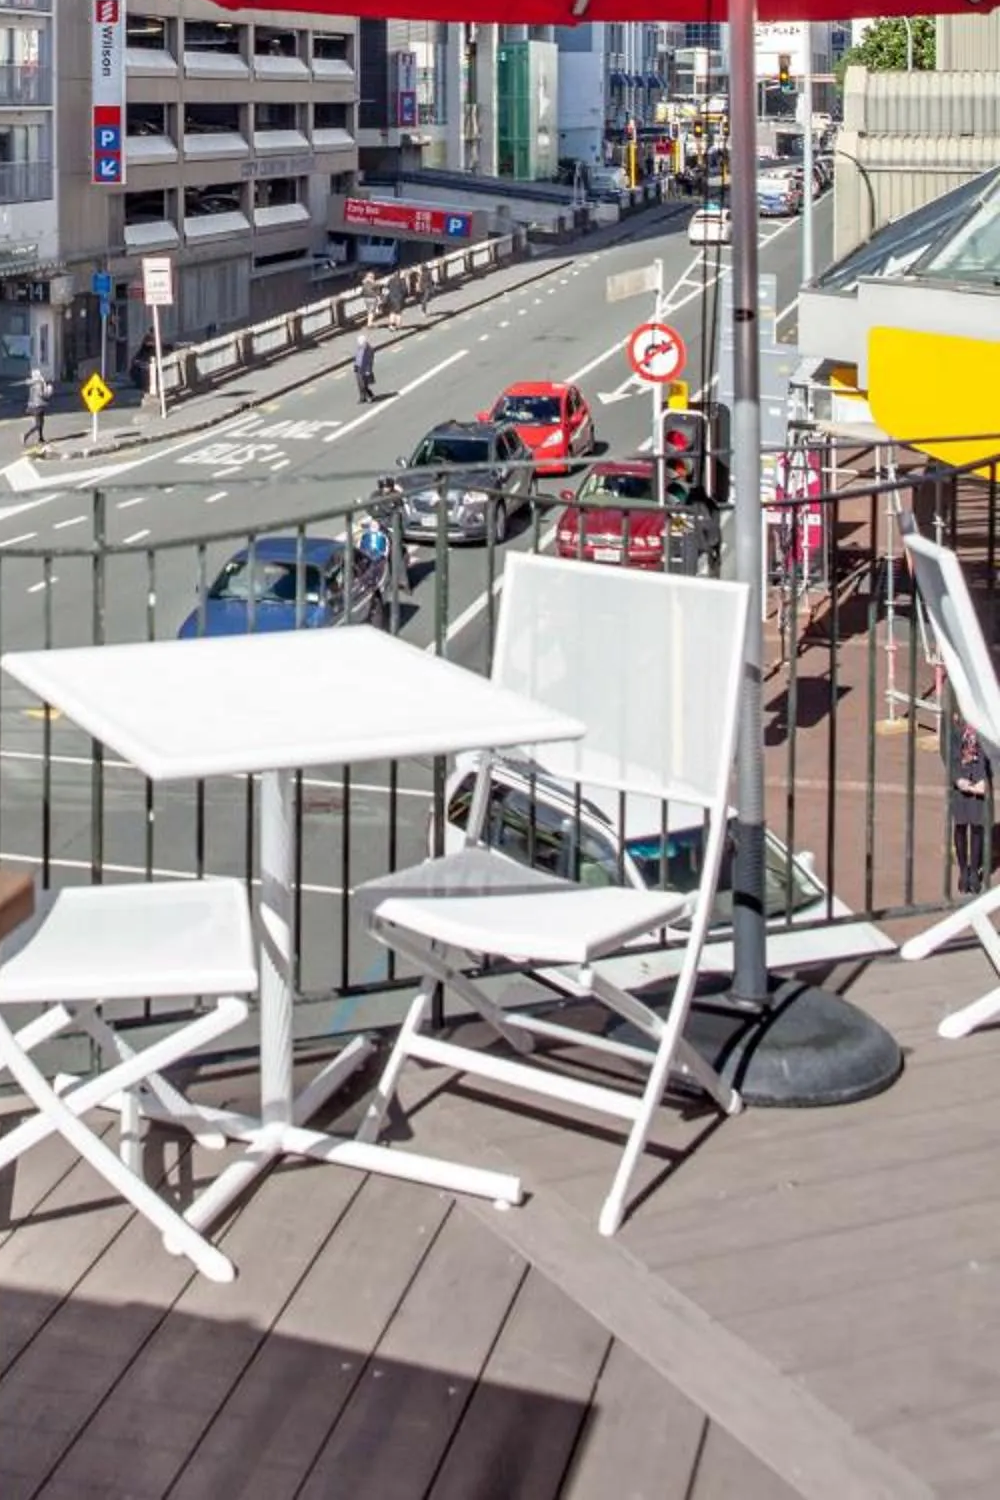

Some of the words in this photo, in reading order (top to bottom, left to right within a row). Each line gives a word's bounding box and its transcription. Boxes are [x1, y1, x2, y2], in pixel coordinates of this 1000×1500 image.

[102, 25, 114, 77] Wilson
[101, 130, 115, 148] P
[449, 217, 462, 234] P
[175, 442, 280, 465] BUS
